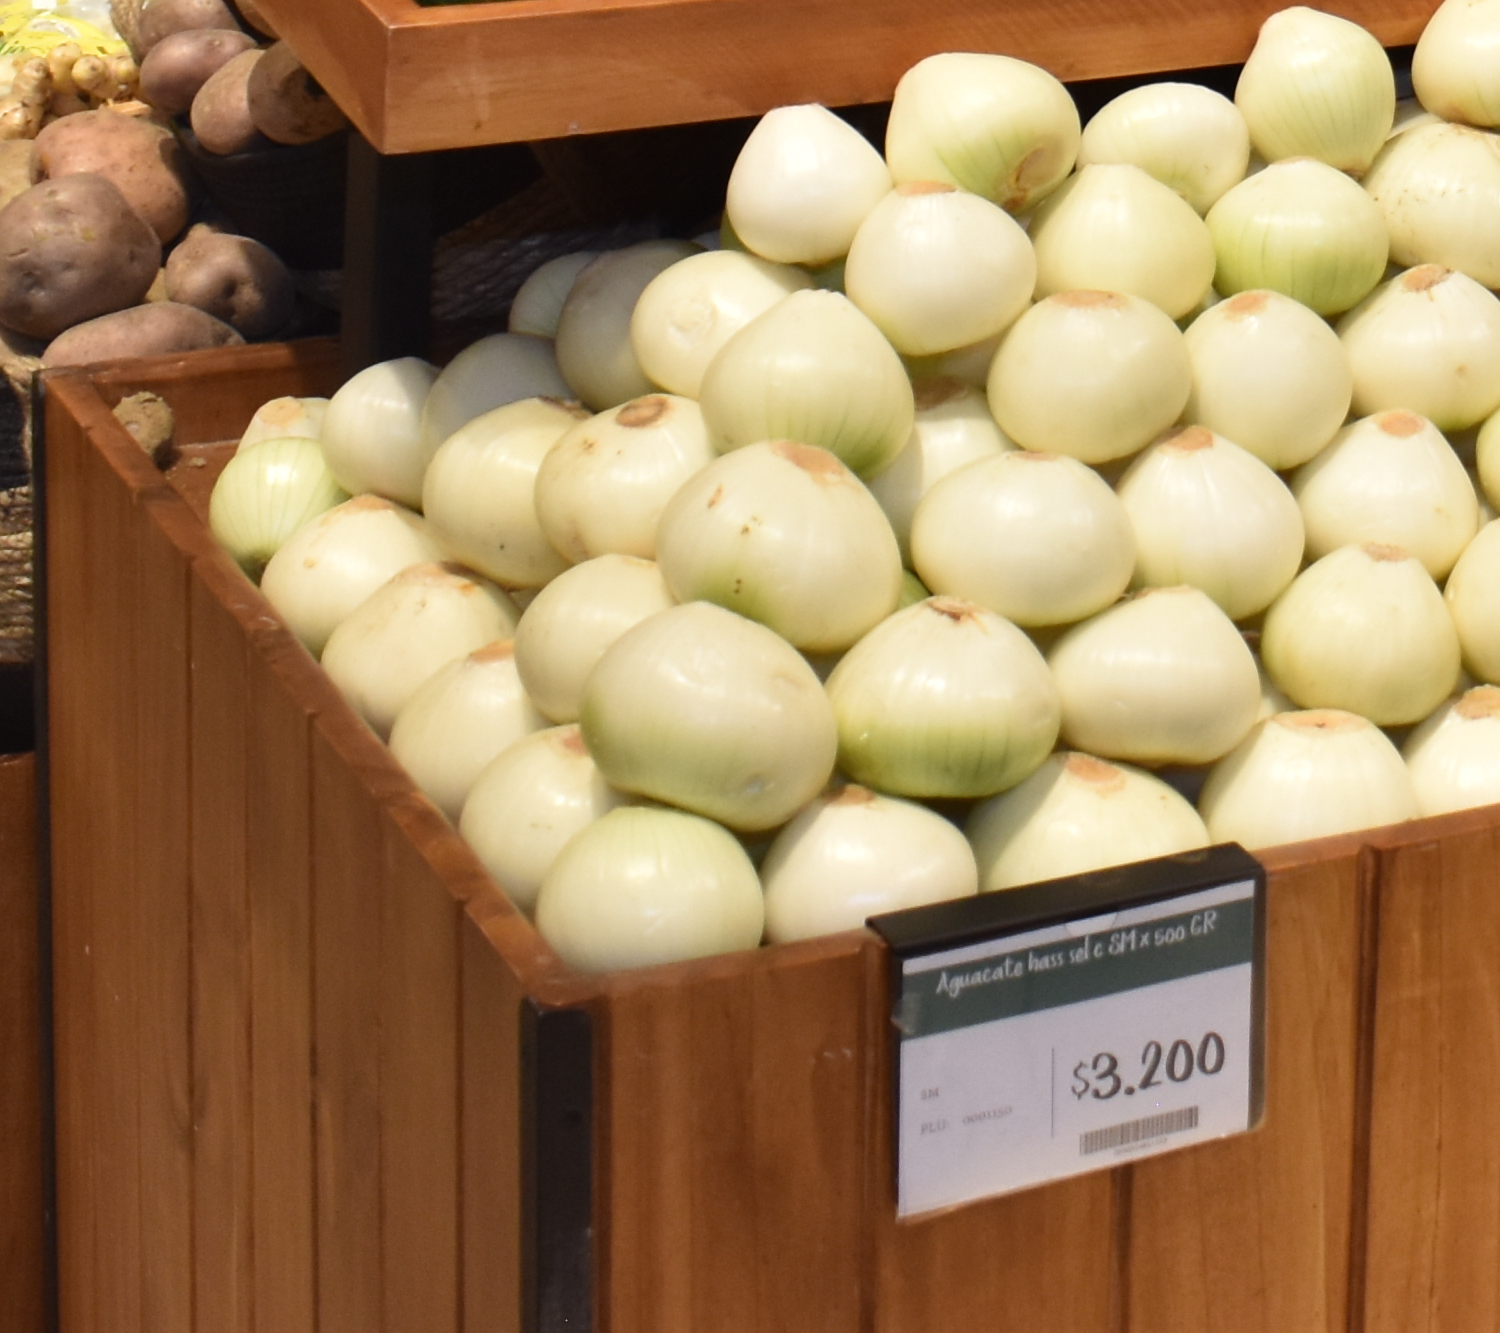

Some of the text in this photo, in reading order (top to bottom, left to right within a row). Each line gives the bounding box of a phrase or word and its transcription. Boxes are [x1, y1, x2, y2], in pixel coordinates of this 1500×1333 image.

[935, 955, 1024, 999] Aguacate
[1027, 947, 1064, 973] hass
[1108, 926, 1138, 956] SM
[1154, 925, 1186, 947] 500
[1069, 1031, 1226, 1101] $3.200
